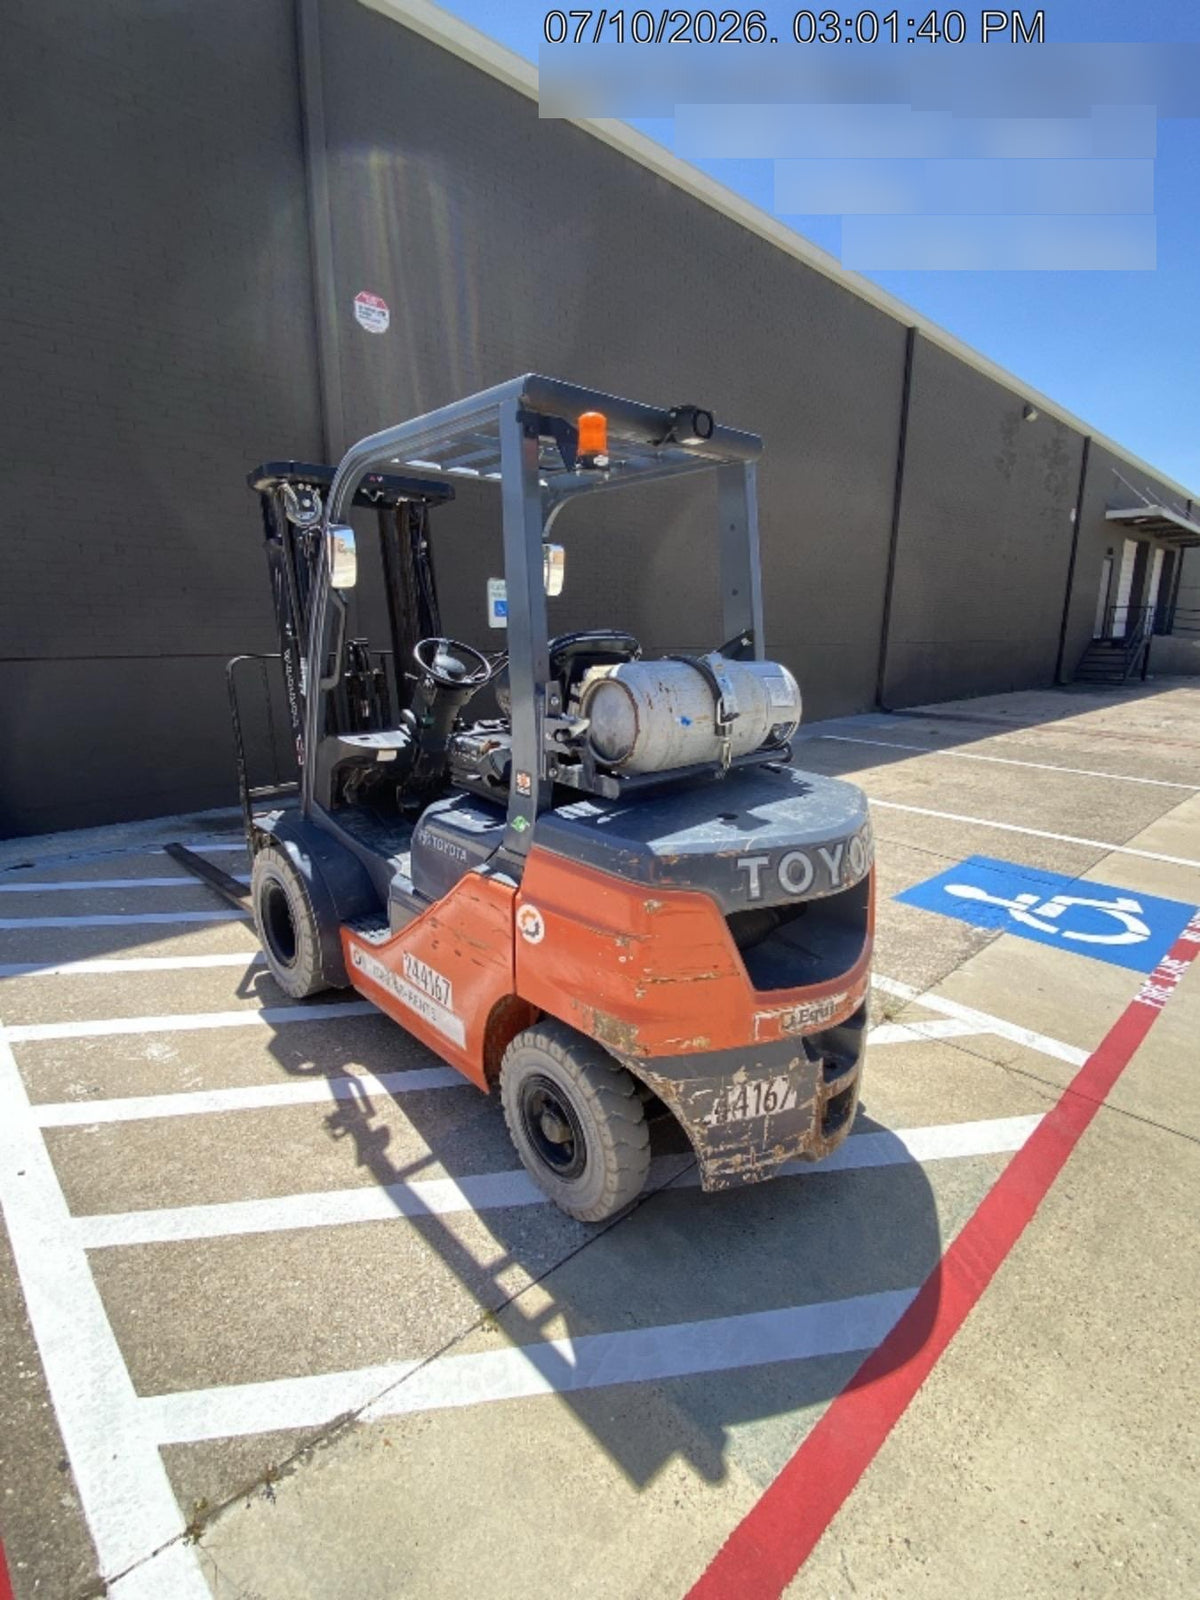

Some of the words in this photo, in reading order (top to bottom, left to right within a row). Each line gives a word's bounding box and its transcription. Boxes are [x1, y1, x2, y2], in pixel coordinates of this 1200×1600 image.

[432, 835, 468, 862] TOYOTA
[737, 824, 873, 898] TOYO
[404, 954, 451, 1005] 244167
